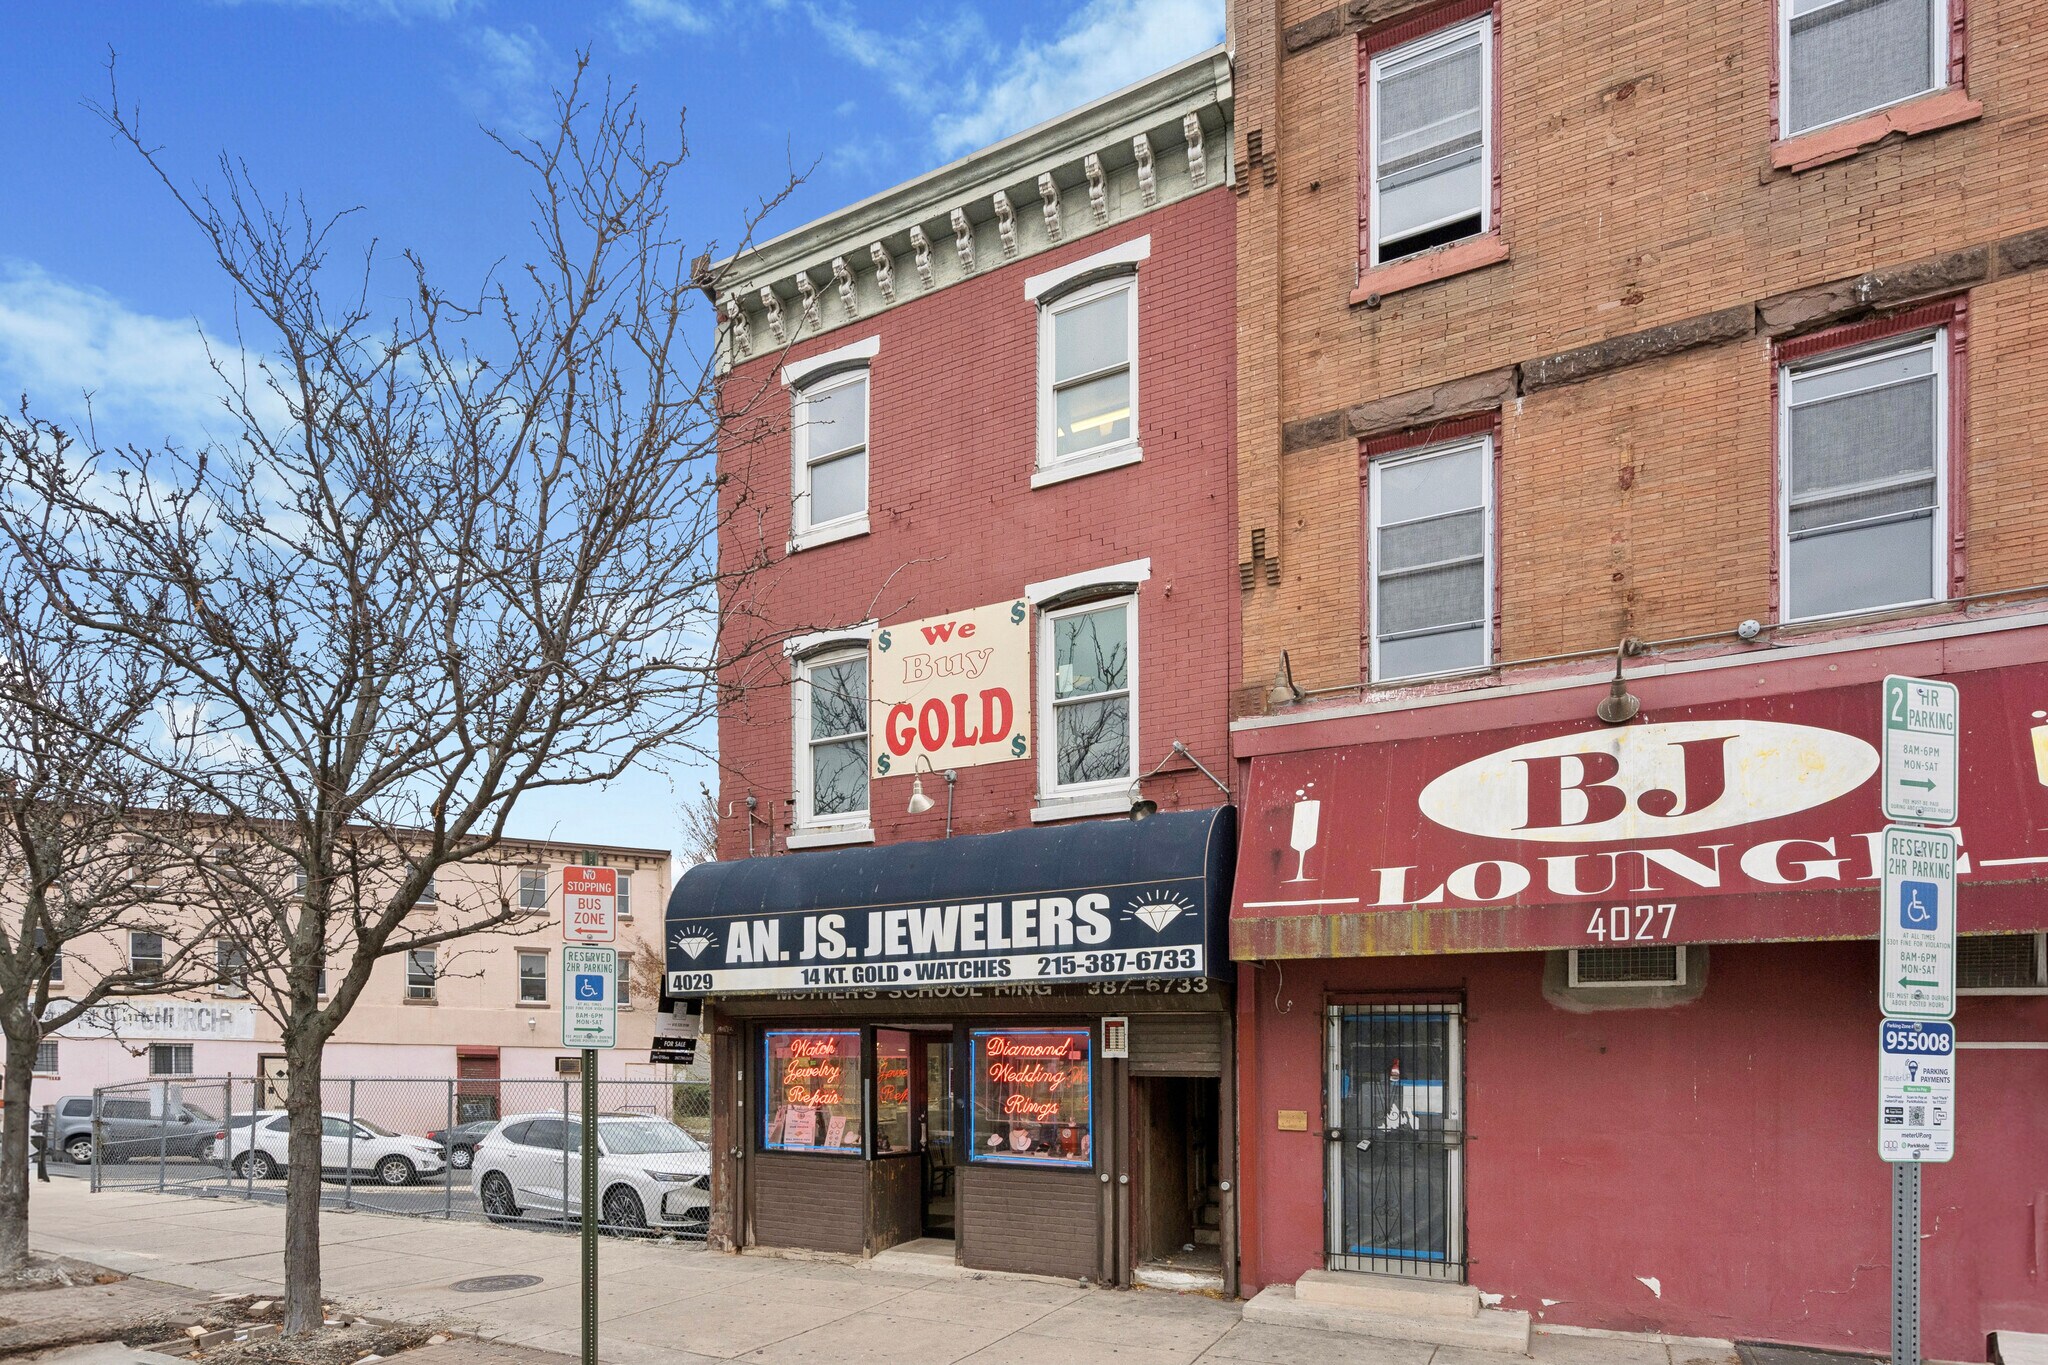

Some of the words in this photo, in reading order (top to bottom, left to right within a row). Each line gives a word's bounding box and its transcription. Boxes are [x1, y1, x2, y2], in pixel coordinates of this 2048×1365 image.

[921, 621, 976, 645] We
[902, 648, 994, 684] Buy
[1891, 686, 1904, 722] 2
[1921, 689, 1939, 707] HR
[885, 687, 1014, 757] GOLD
[1909, 709, 1953, 731] PARKING
[1903, 744, 1940, 757] 8AM-6PM
[1904, 760, 1938, 771] MON-SAT
[1511, 735, 1738, 831] BJ
[1892, 837, 1948, 859] RESERVED
[582, 869, 596, 880] NO
[1889, 858, 1907, 875] 2HR
[1912, 860, 1950, 879] PARKING
[567, 881, 612, 893] STOPPING
[578, 898, 601, 910] BUS
[574, 912, 605, 925] ZONE
[725, 920, 790, 963] AN.
[801, 914, 857, 959] JS.
[863, 893, 1112, 957] JEWELERS
[1586, 903, 1678, 943] 4027
[1925, 941, 1951, 949] VIOLATION
[568, 951, 611, 963] RESERVED
[1038, 949, 1196, 976] 215-387-6733
[1900, 951, 1937, 963] 8AM-6PM
[566, 962, 581, 972] 2HR
[583, 963, 613, 974] PARKING
[801, 968, 820, 985] 14
[824, 967, 849, 984] KT.
[852, 965, 899, 983] GOLD
[916, 958, 1011, 980] WATCHES
[1901, 964, 1936, 975] MON-SAT
[672, 973, 714, 991] 4029
[791, 1037, 835, 1057] Watch
[987, 1037, 1071, 1057] Diamond
[1886, 1031, 1950, 1052] 955008
[784, 1059, 840, 1084] Jewelry
[990, 1063, 1066, 1091] Wedding
[788, 1085, 839, 1108] Repair
[1005, 1094, 1059, 1121] Rings
